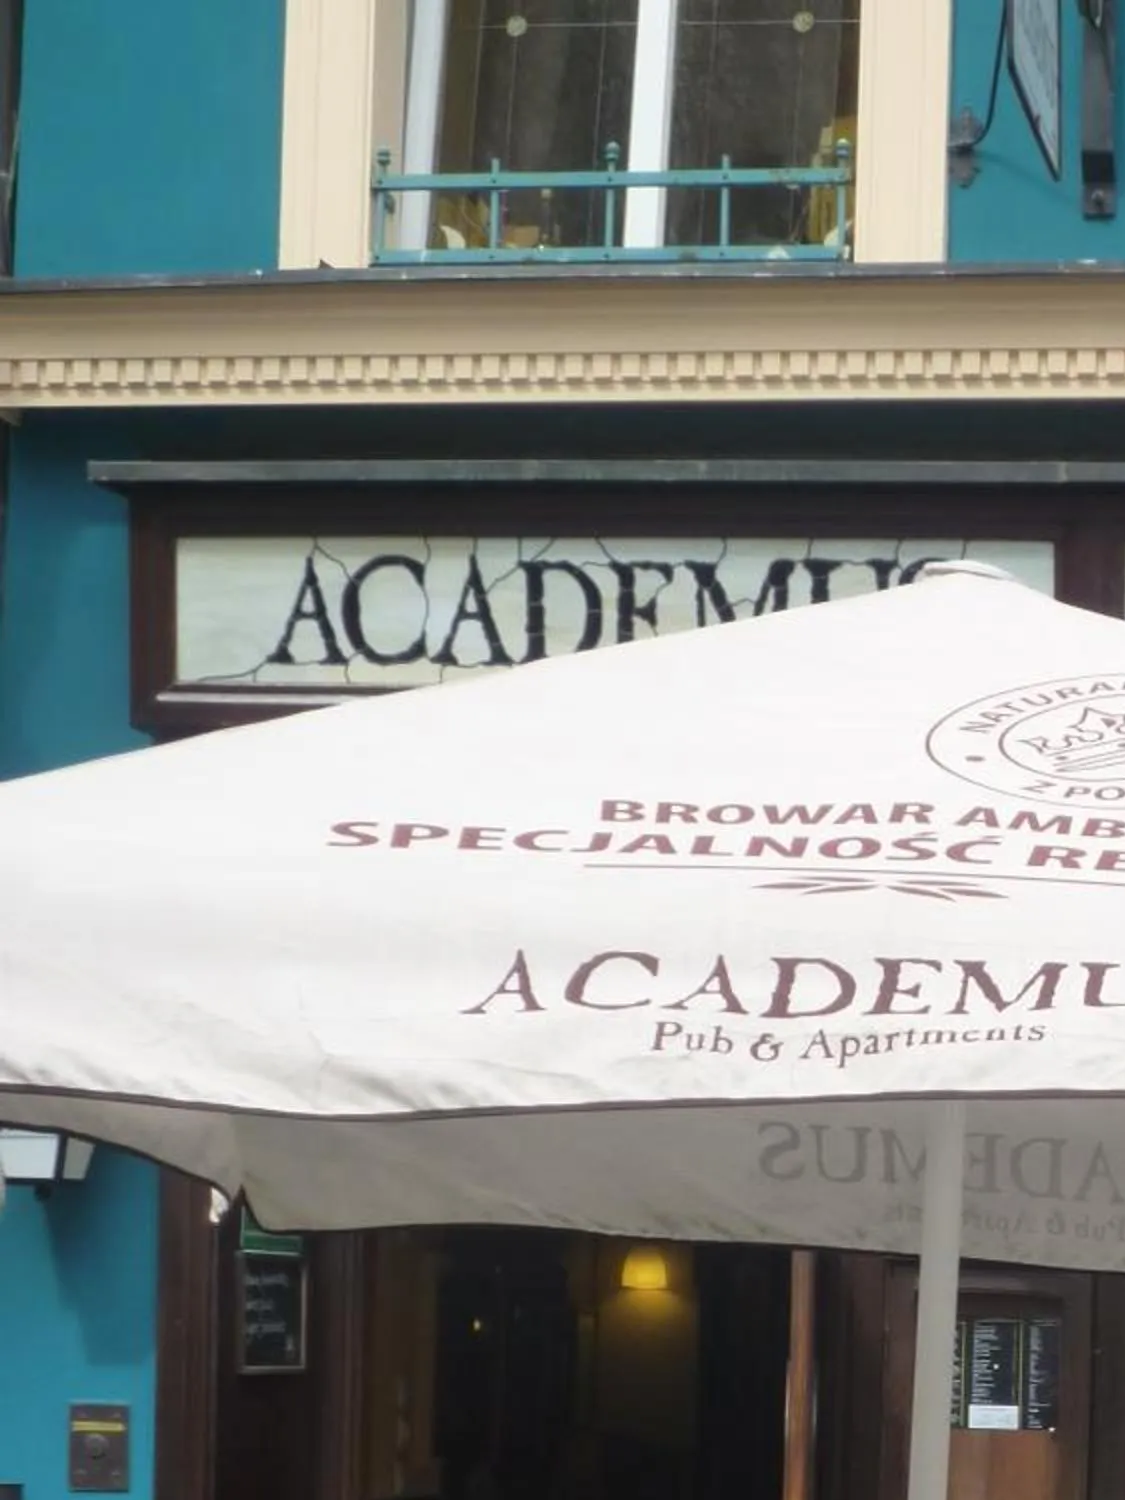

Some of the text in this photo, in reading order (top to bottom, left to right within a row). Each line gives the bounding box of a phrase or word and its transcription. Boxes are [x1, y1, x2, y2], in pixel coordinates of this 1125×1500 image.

[267, 553, 948, 666] ACADEM
[1022, 778, 1058, 794] Z
[600, 799, 936, 825] BROWAR
[326, 820, 1003, 865] SPECJALNOŚĆ
[651, 1021, 1047, 1069] Pub & Apartments
